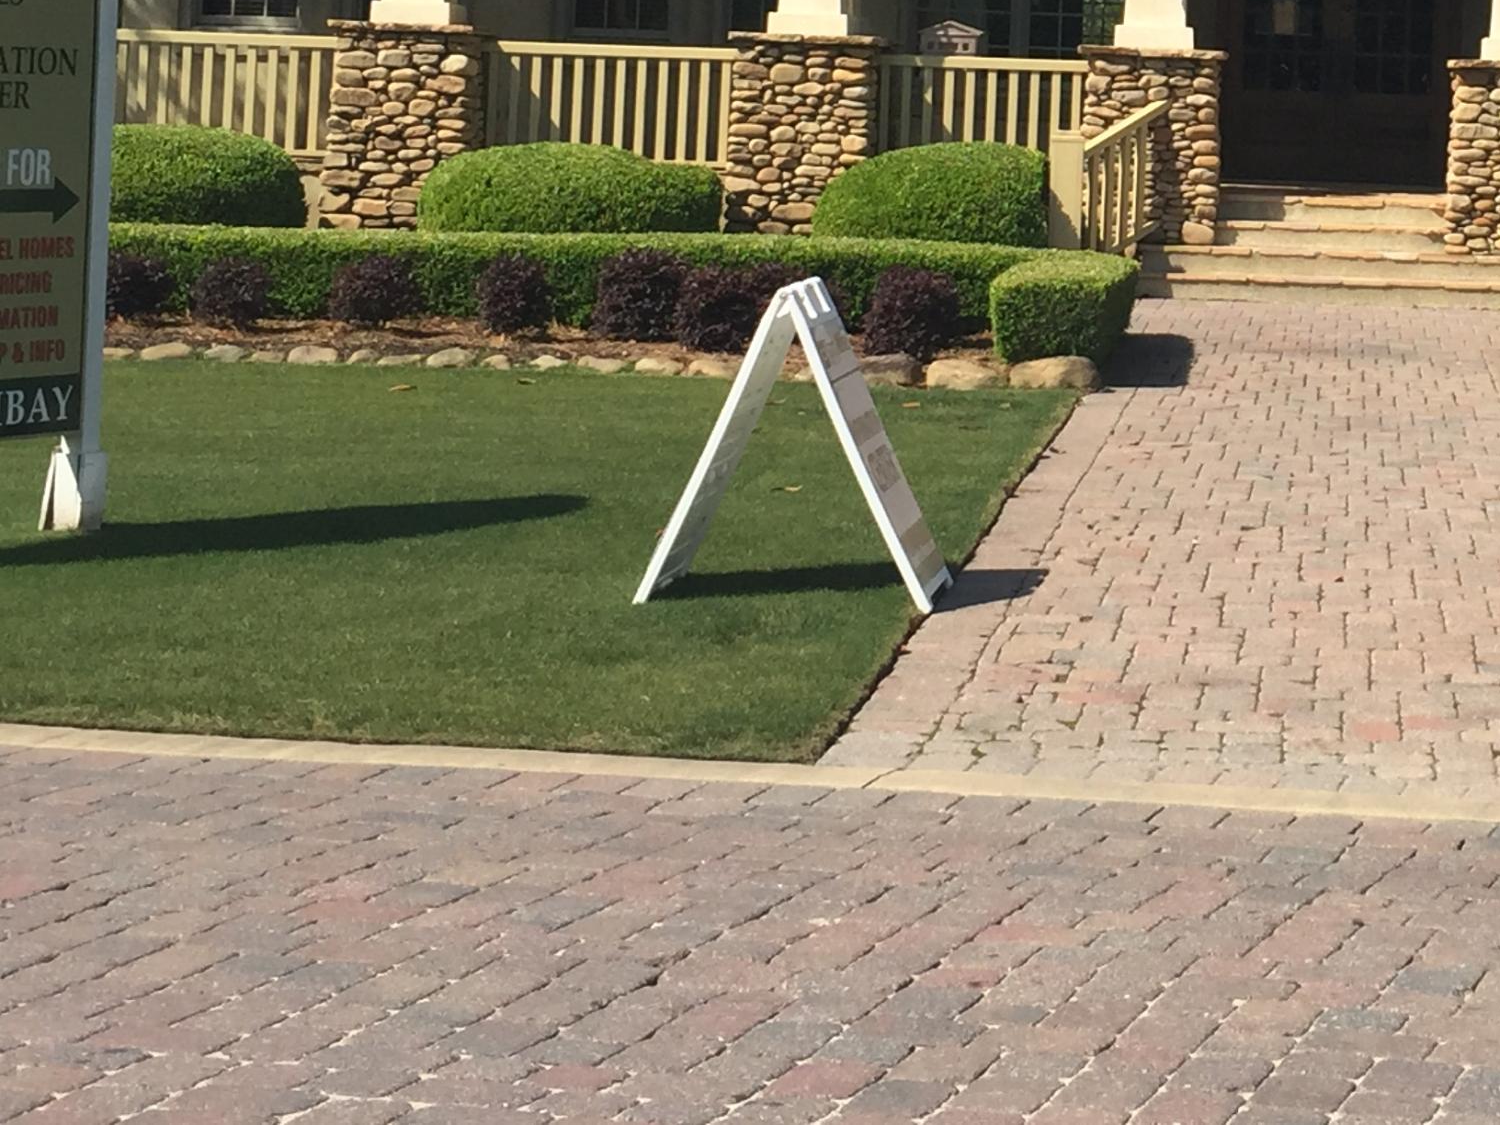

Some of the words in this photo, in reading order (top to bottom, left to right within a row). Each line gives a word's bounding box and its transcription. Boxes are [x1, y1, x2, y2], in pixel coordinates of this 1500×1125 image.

[7, 148, 51, 186] FOR
[19, 236, 75, 260] HOMES
[30, 339, 65, 362] INFO
